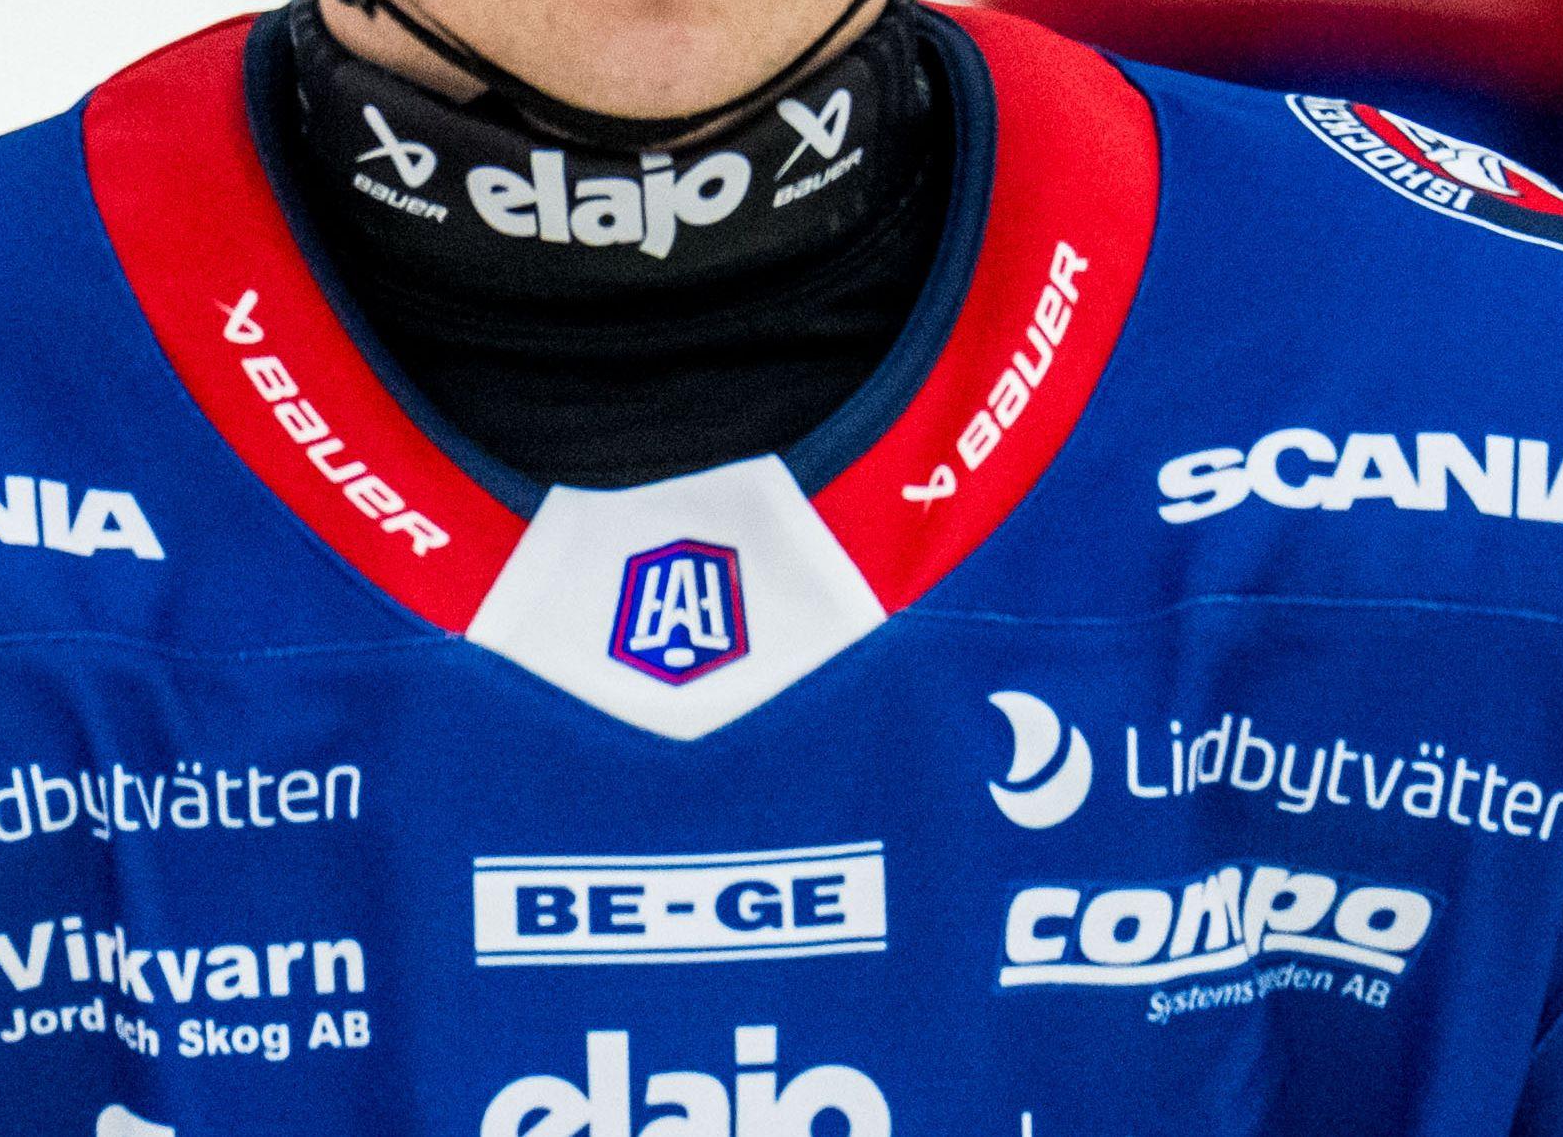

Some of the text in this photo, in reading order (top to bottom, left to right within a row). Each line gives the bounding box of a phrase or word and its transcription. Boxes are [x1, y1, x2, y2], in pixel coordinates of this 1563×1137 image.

[354, 174, 448, 222] BAUER
[467, 151, 751, 258] elajo
[773, 148, 863, 208] BAUER
[957, 242, 1088, 470] BAUER
[241, 356, 450, 557] BAUER
[1006, 866, 1432, 965] compo
[1, 997, 105, 1043] Jord
[178, 1018, 290, 1062] Skog
[309, 1010, 371, 1050] AB
[1342, 973, 1391, 1008] AB
[480, 1024, 892, 1137] elajo
